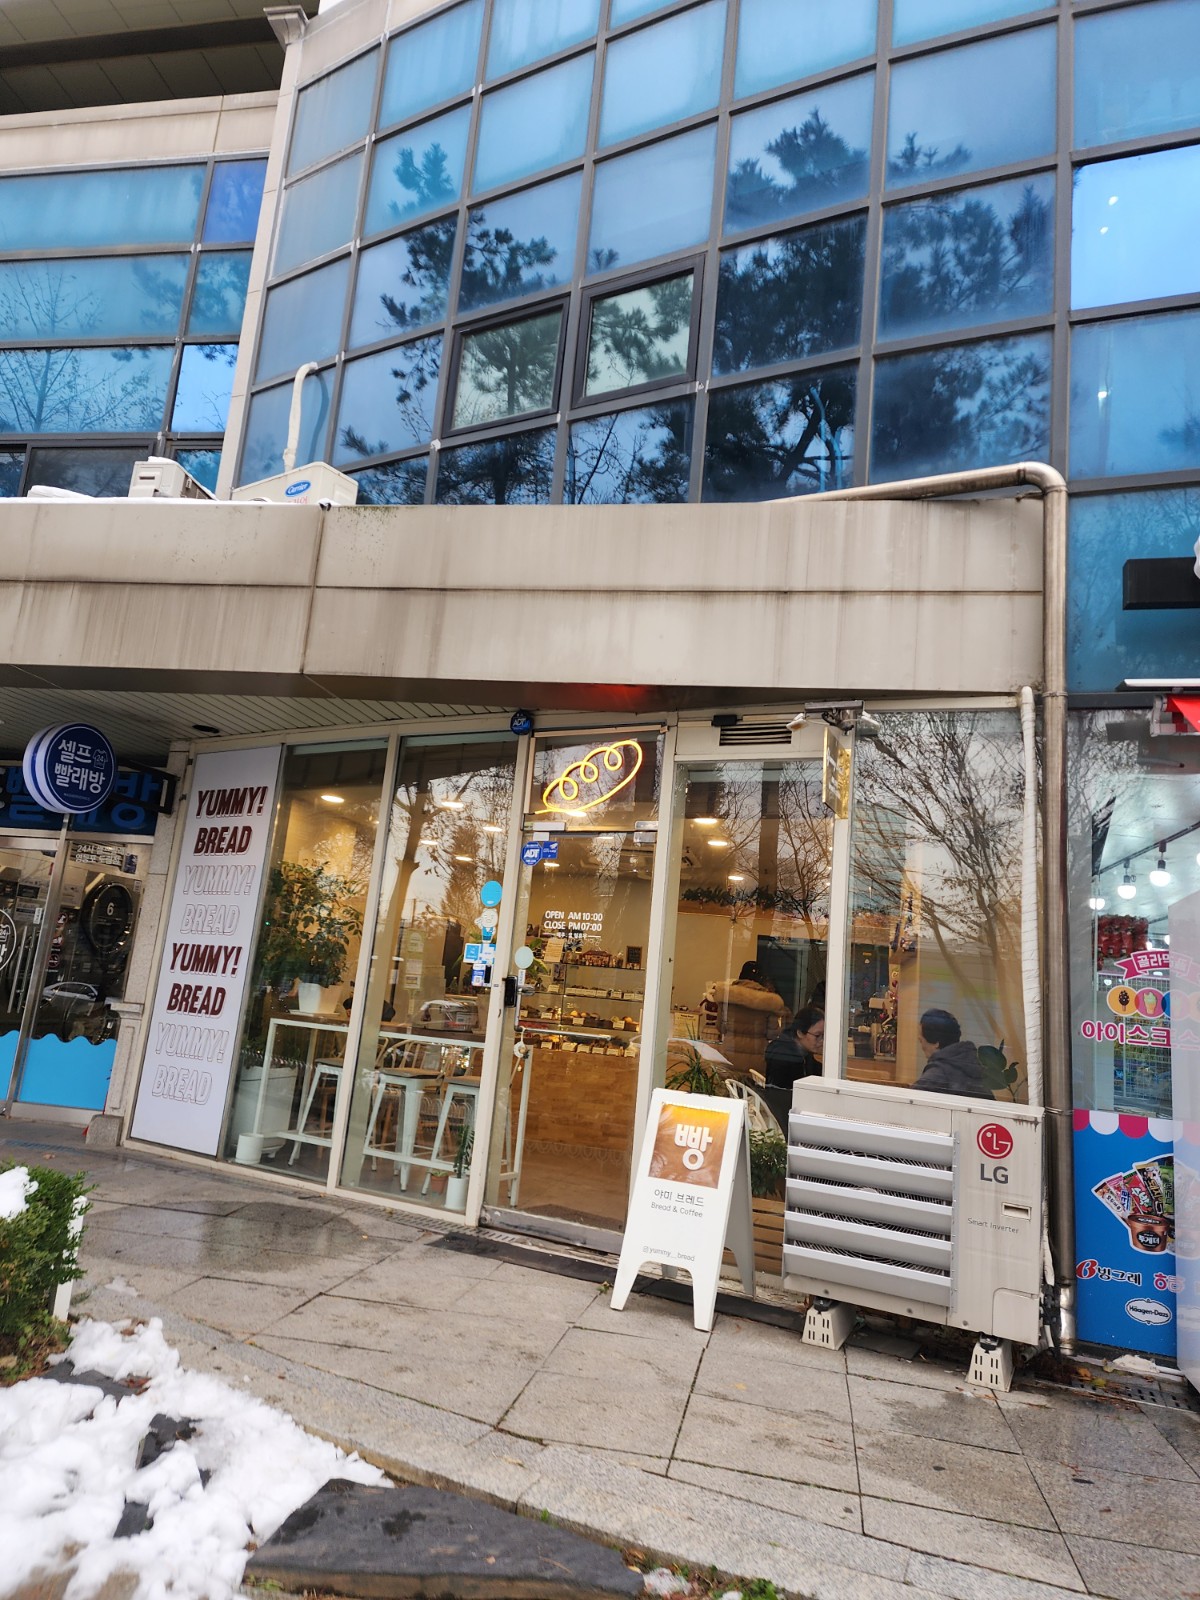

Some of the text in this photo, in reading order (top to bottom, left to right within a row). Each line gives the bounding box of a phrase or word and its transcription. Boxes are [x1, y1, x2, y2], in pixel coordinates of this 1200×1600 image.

[512, 718, 527, 726] ADT
[58, 738, 92, 763] 셀프
[54, 762, 106, 794] 빨래방
[195, 786, 269, 817] YUMMY!
[193, 825, 252, 856] BREAD
[523, 848, 540, 858] ADT
[183, 864, 256, 897] YUMMY!
[106, 902, 114, 915] 6
[180, 904, 240, 938] BREAD
[545, 910, 603, 921] OPEN AM 10:00
[543, 920, 602, 931] CLOSE PM 07:00
[169, 943, 243, 977] YUMMY!
[166, 986, 227, 1017] BREAD
[155, 1022, 229, 1062] YUMMY!
[151, 1064, 212, 1105] BREAD
[674, 1123, 713, 1170] 빵
[980, 1163, 1009, 1185] LG
[651, 1201, 703, 1218] Bread & Coffee
[654, 1189, 704, 1207] 야미 브레드
[967, 1217, 1020, 1234] Smart Inverter
[1097, 1266, 1142, 1287] 빙그레
